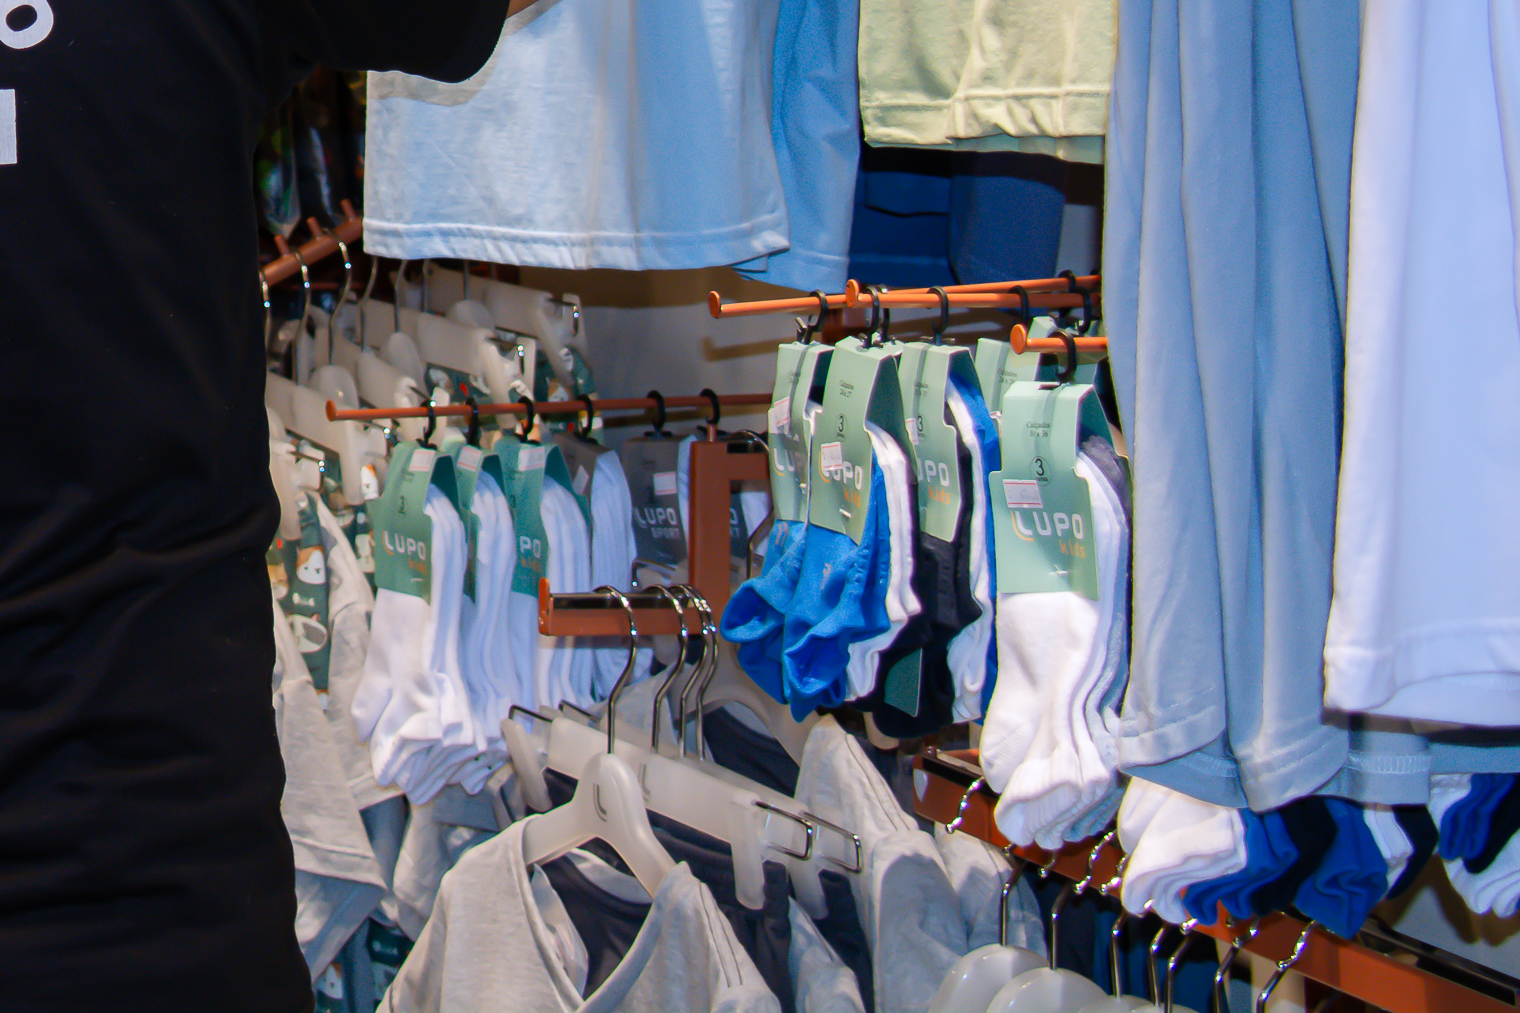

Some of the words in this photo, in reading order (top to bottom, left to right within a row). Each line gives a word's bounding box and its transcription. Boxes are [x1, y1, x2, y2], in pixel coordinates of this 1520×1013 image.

[917, 458, 950, 486] PO
[1034, 458, 1045, 477] 3
[928, 485, 950, 504] kids
[633, 506, 678, 529] LUPO
[1010, 510, 1085, 541] LUPO
[382, 531, 426, 561] LUPO
[519, 536, 542, 558] PO
[1059, 539, 1086, 558] kids
